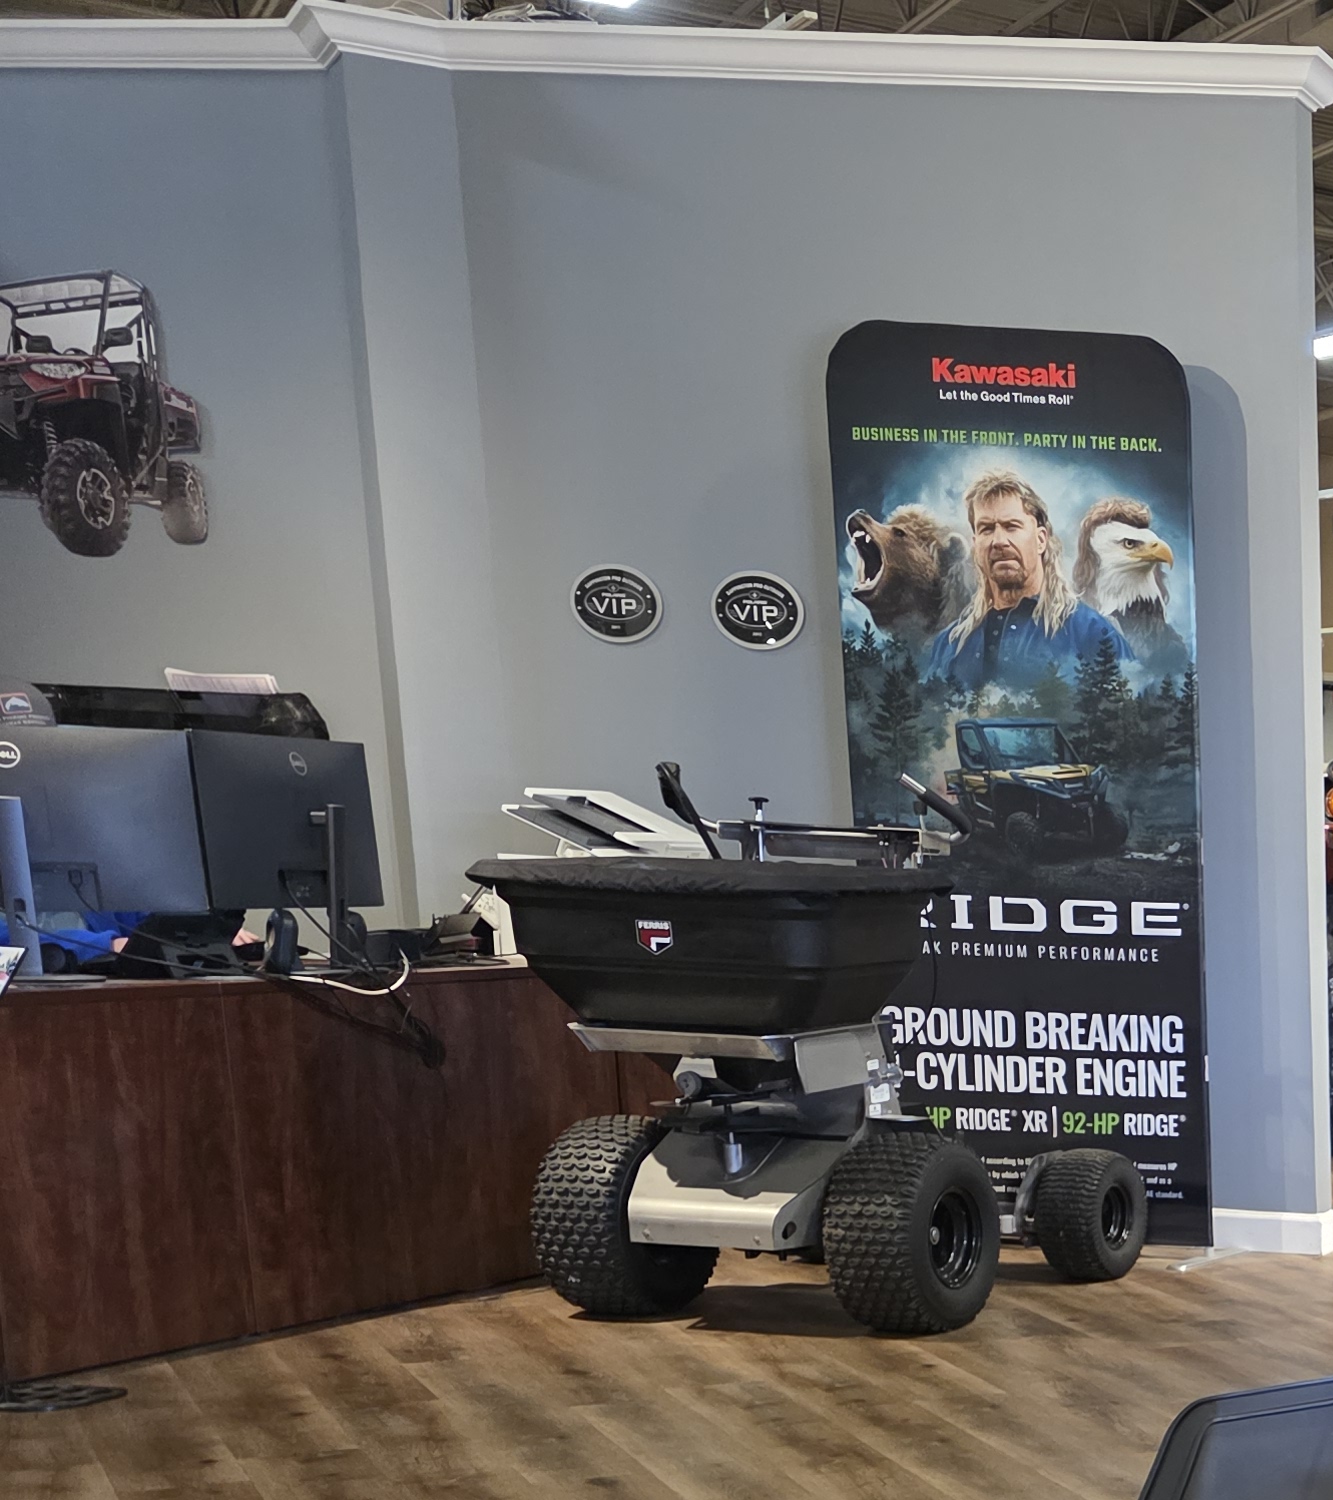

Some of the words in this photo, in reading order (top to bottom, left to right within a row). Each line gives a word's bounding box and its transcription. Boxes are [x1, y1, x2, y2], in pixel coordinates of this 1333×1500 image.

[932, 357, 1076, 388] Kawasaki
[939, 389, 957, 401] Let
[960, 390, 978, 402] the
[980, 391, 1010, 403] Good
[1012, 392, 1046, 405] Times
[852, 427, 919, 442] BUSINESS
[924, 430, 938, 443] IN
[941, 430, 967, 444] THE
[971, 431, 1019, 446] FRONT.
[1024, 434, 1068, 449] PARTY
[1072, 435, 1086, 449] IN
[1090, 436, 1117, 451] THE
[1120, 437, 1162, 453] BACK.
[592, 597, 636, 615] VIP
[733, 603, 778, 622] VIP
[0, 750, 17, 760] ELL
[638, 921, 670, 930] FERRIS
[951, 942, 1028, 959] PREMIUM
[1038, 945, 1159, 963] PERFORMANCE
[881, 1005, 1016, 1049] GROUND
[1025, 1011, 1183, 1054] BREAKING
[894, 1050, 1067, 1095] -CYLINDER
[1076, 1057, 1187, 1098] ENGINE
[1022, 1111, 1048, 1133] XR
[1062, 1112, 1120, 1135] 92-HP
